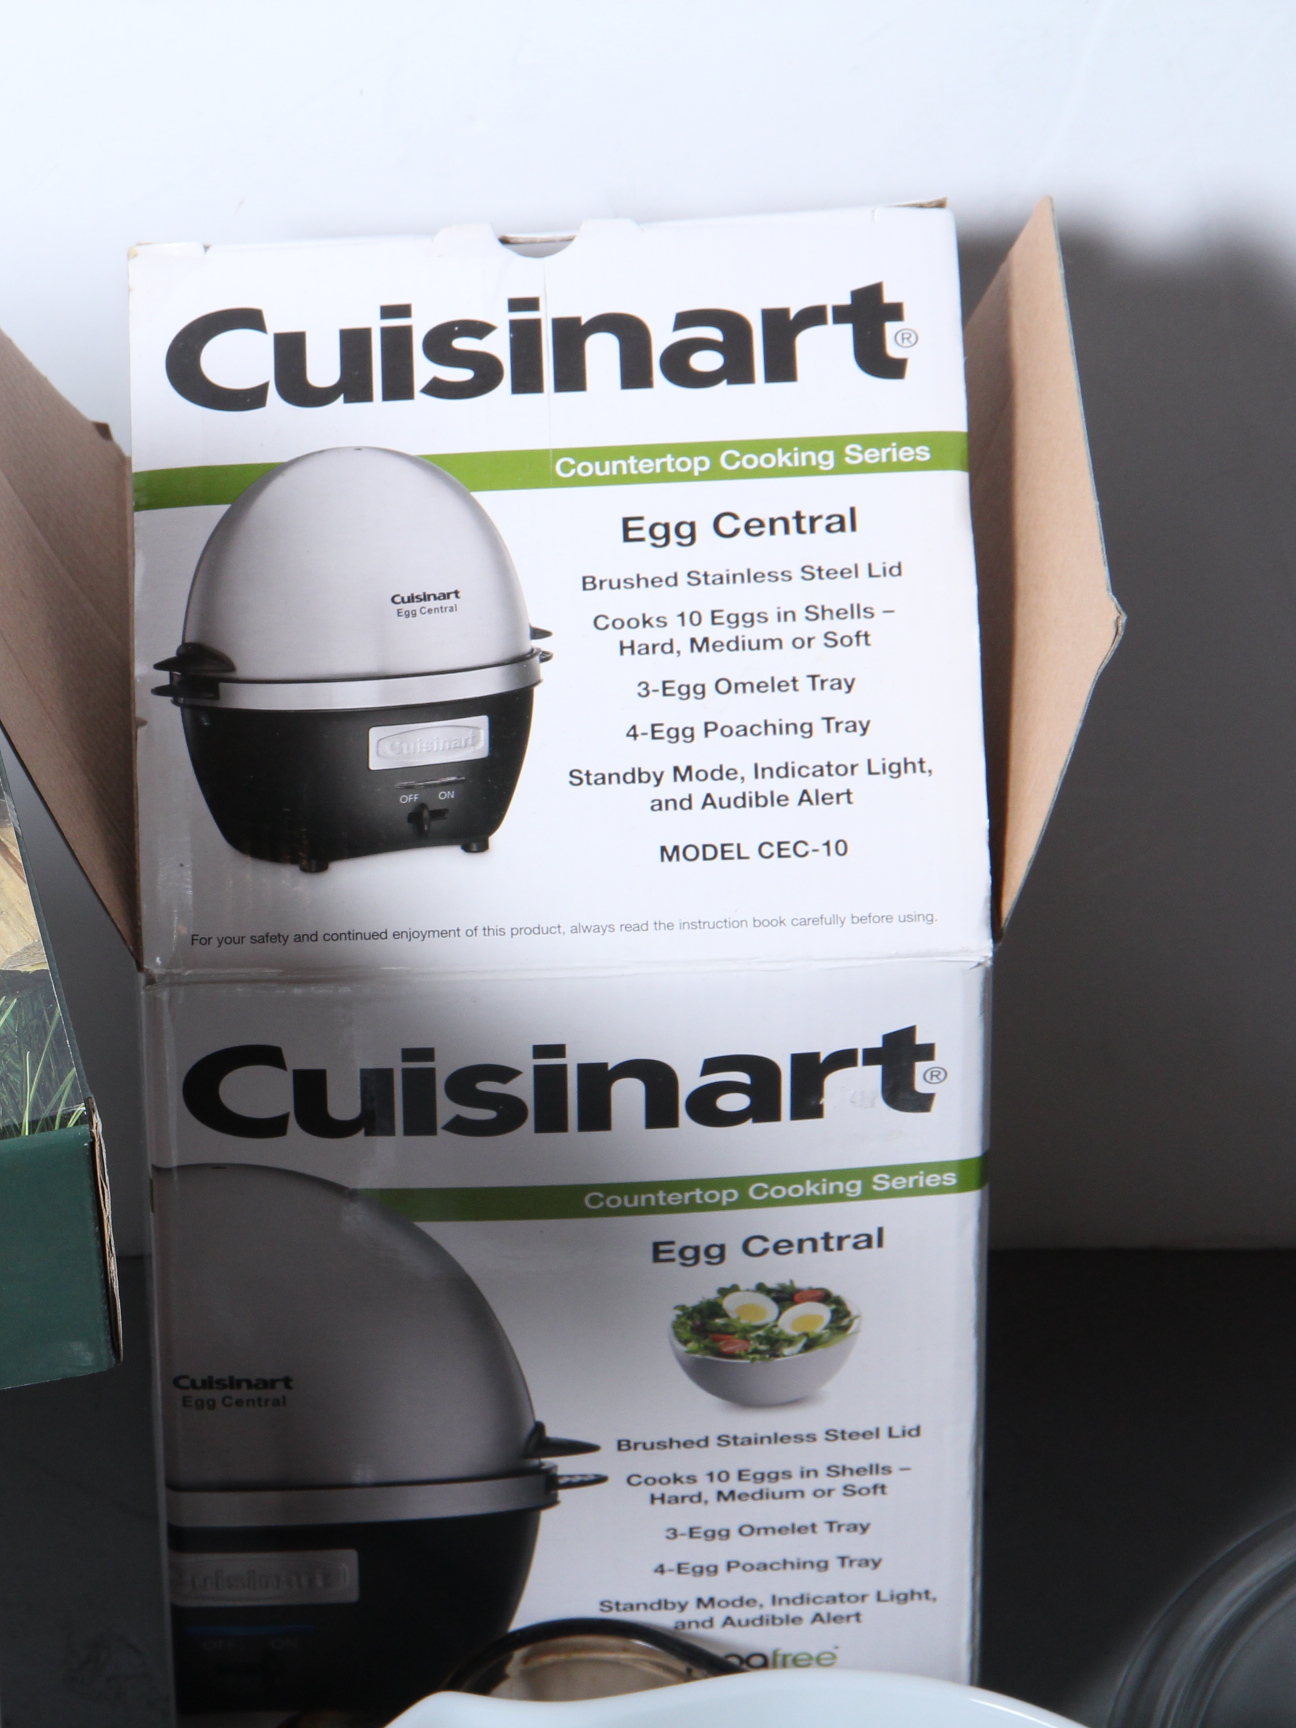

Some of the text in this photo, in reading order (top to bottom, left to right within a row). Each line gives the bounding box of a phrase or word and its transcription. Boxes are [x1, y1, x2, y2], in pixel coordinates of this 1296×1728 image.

[555, 442, 931, 477] Countertop Cooking Series
[622, 506, 858, 548] Egg Central
[581, 561, 903, 591] Brushed Stainless Steel Lid
[391, 589, 461, 605] Cuisinart
[397, 604, 458, 619] Egg Central
[593, 603, 875, 631] Cooks 10 Eggs in Shells
[619, 630, 872, 657] Hard, Medium or Soft
[637, 674, 856, 700] 3-Egg Omelet Tray
[625, 716, 871, 743] 4-Egg Poaching Tray
[568, 757, 933, 787] Standby Mode, Indicator Light,
[400, 791, 455, 803] OFF ON
[650, 788, 854, 811] and Audible Alert
[660, 839, 849, 862] MODEL CEC-10
[191, 911, 938, 949] For your safety and continued enjoyment of this product, always read the instruction book carefully before using.
[584, 1171, 957, 1209] Countertop Cooking Series
[652, 1226, 884, 1267] Egg Central
[616, 1425, 922, 1452] Brushed Stainless Steel Lid
[626, 1463, 892, 1487] Cooks 10 Eggs in Shells
[650, 1483, 888, 1507] Hard, Medium or Soft
[665, 1520, 871, 1542] 3-Egg Omelet Tray
